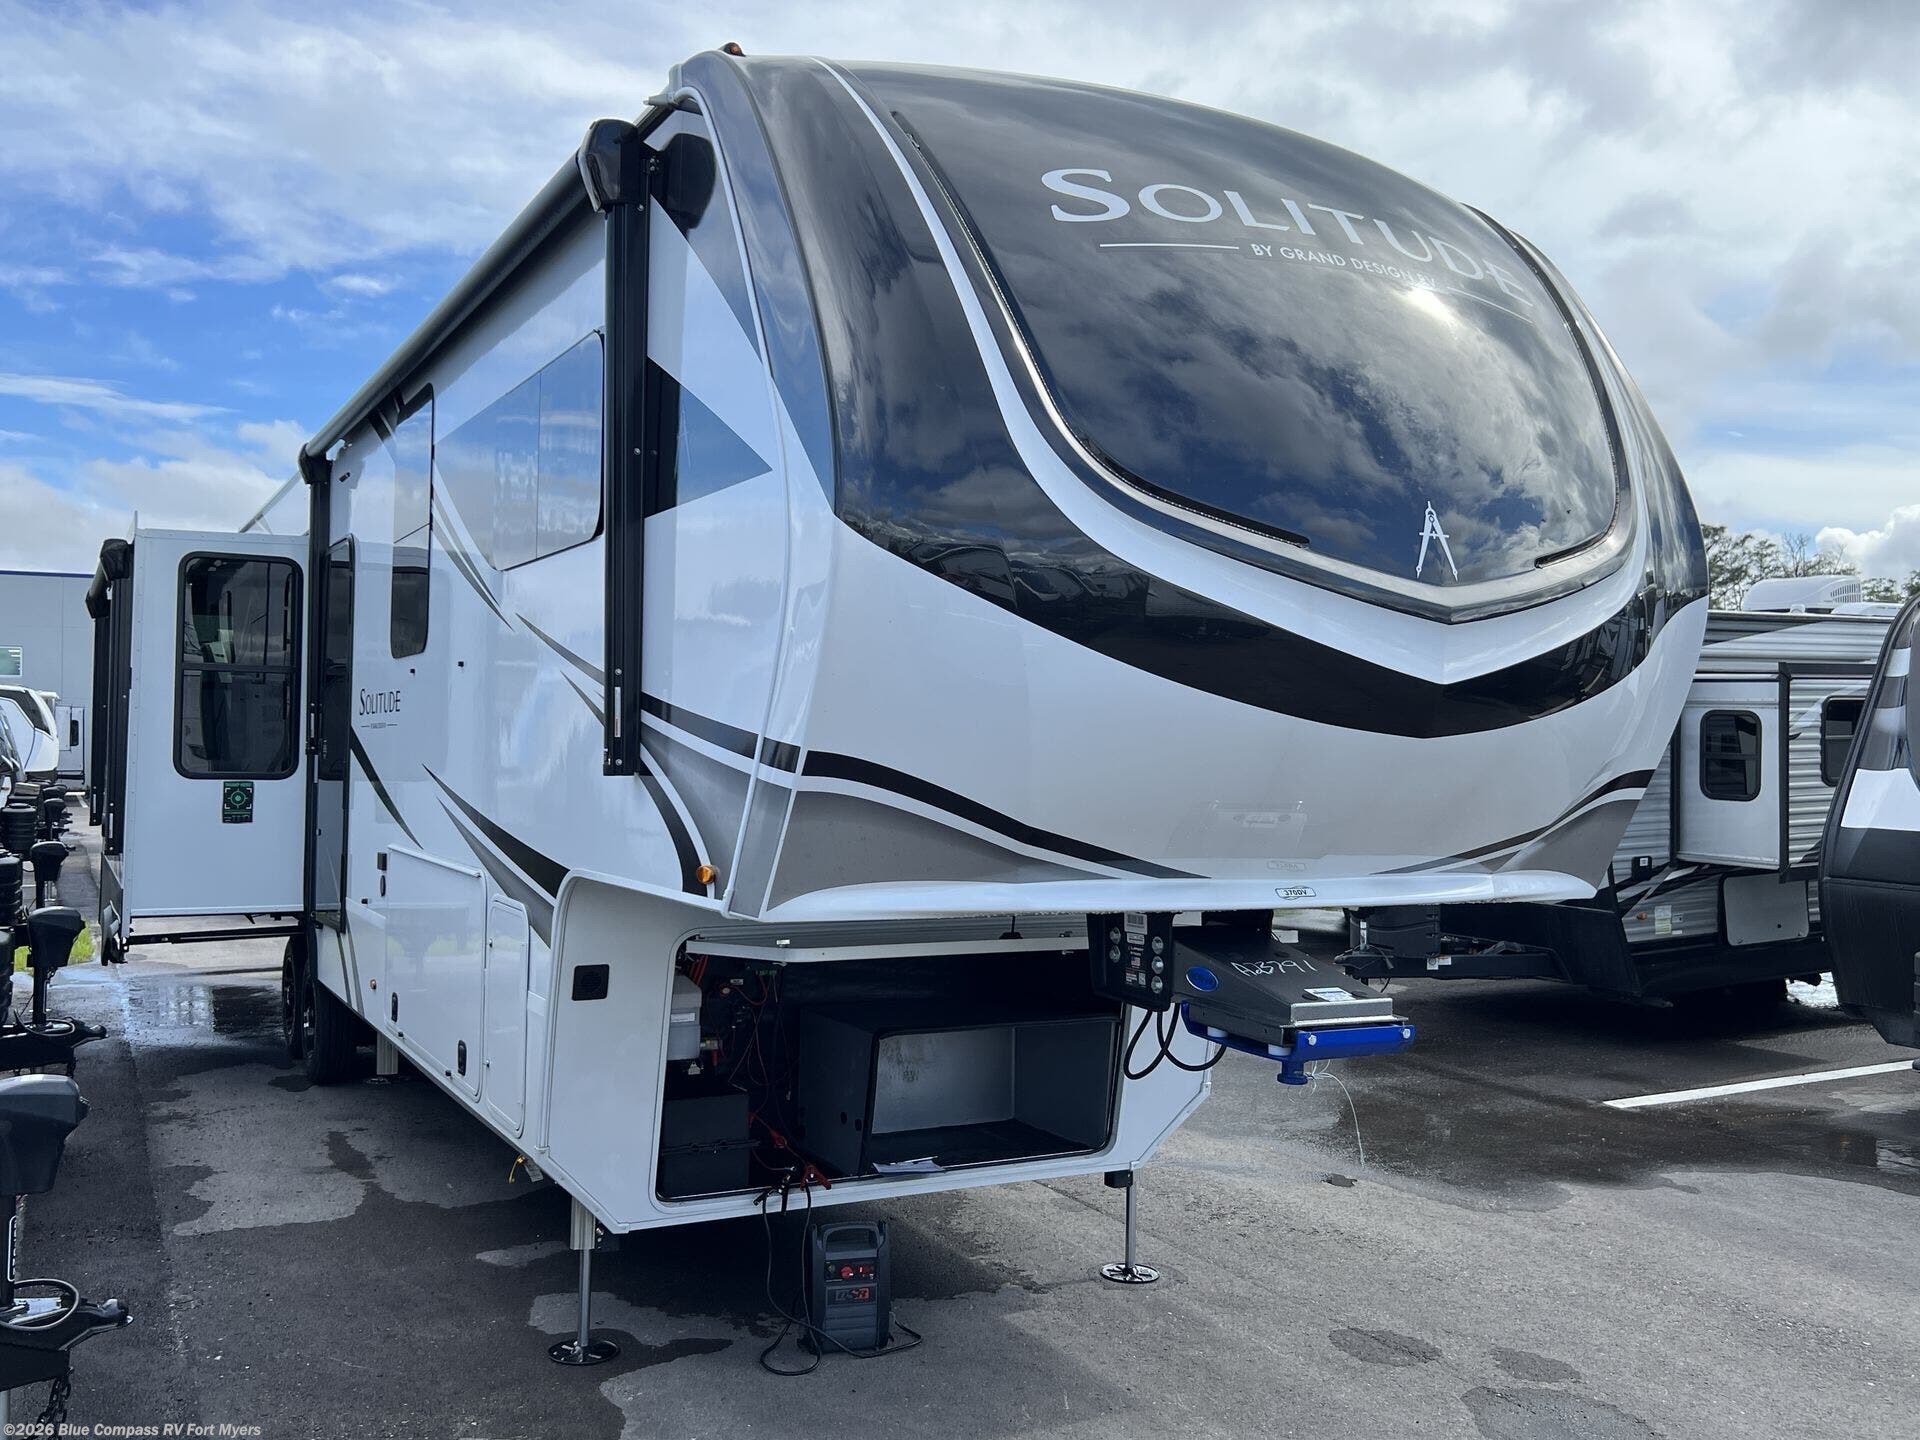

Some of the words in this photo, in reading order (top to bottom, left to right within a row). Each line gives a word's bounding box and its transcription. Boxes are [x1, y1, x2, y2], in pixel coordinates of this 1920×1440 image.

[1041, 168, 1534, 307] SOLITUDE
[1251, 243, 1272, 257] BY
[1280, 247, 1346, 267] GRAND
[1350, 257, 1413, 284] DESIGN
[359, 688, 401, 716] SOLITUDE
